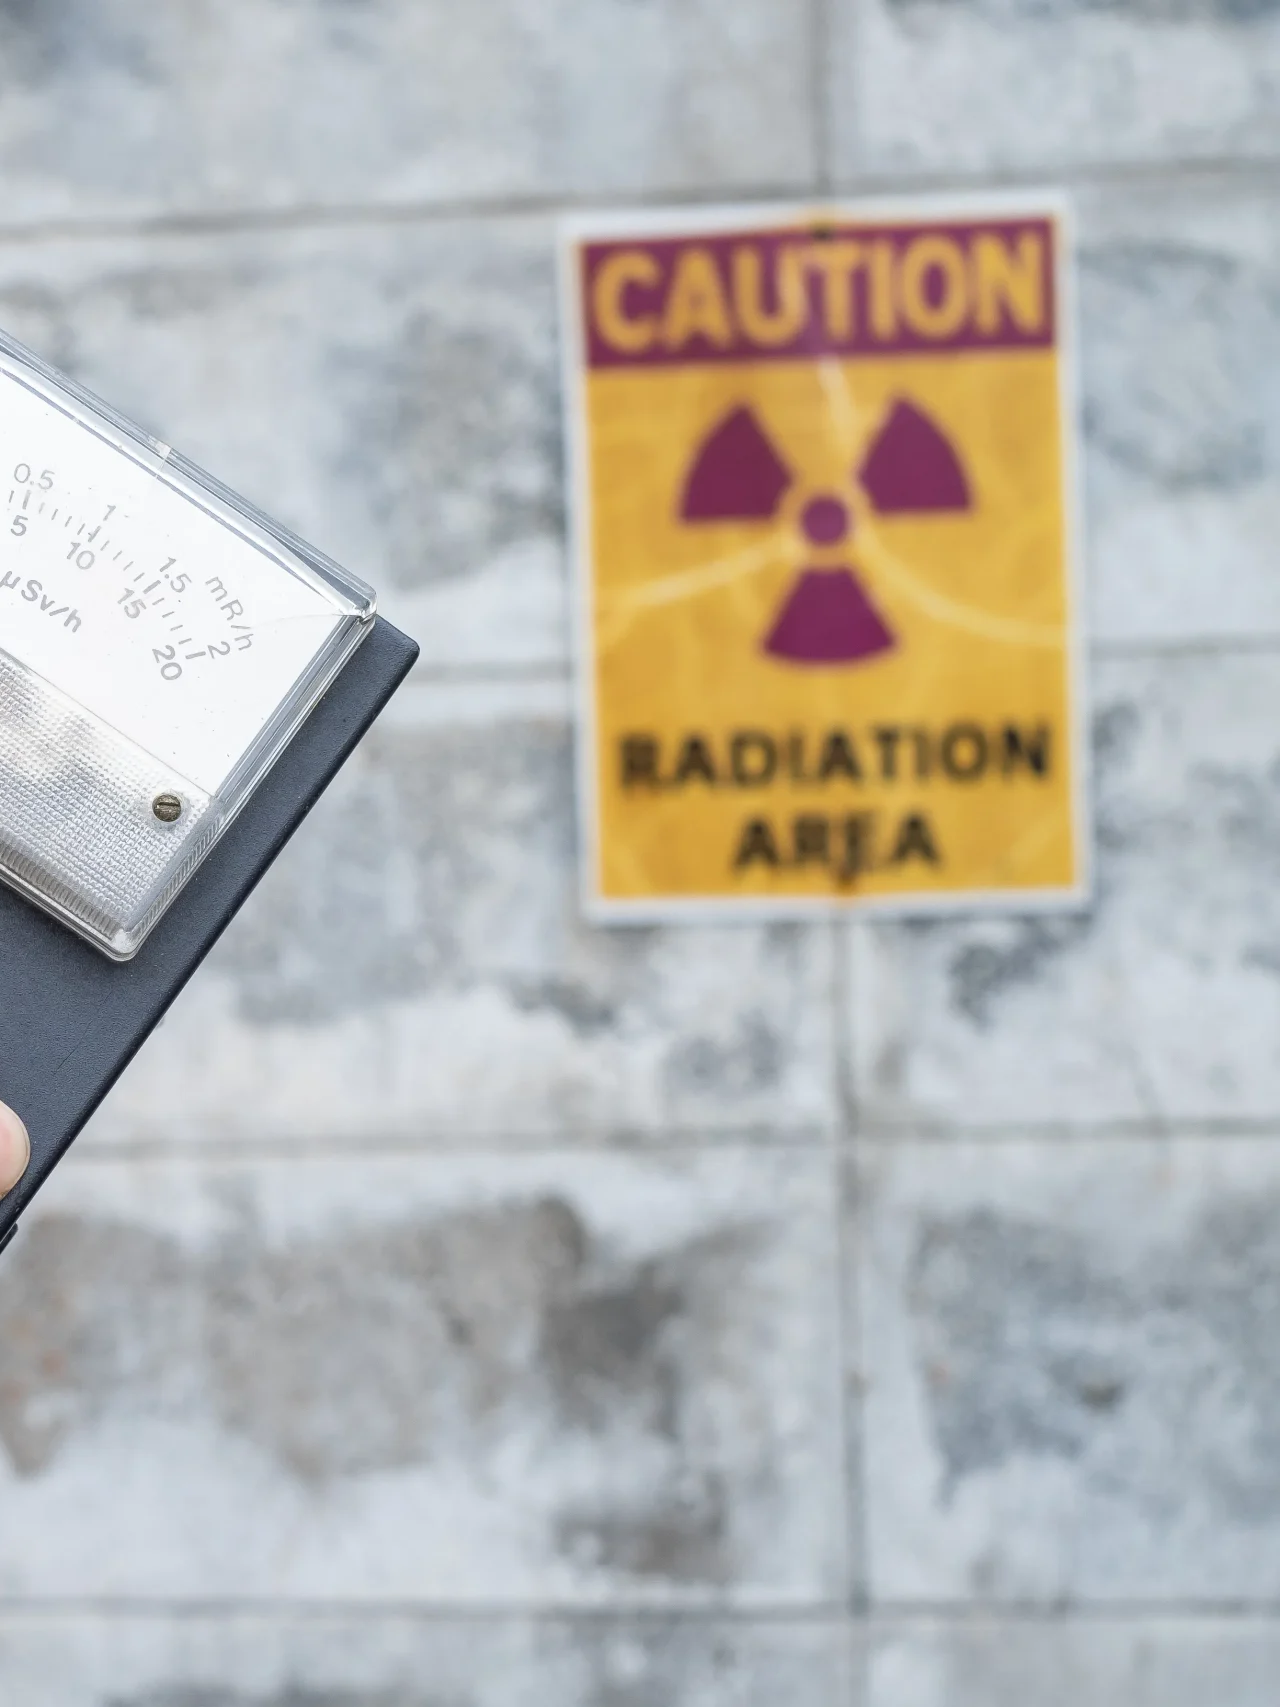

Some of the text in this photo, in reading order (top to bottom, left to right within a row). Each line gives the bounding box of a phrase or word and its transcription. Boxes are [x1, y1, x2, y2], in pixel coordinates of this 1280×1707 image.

[592, 232, 1044, 354] CAUTION
[10, 515, 28, 537] 5
[66, 542, 96, 570] 10
[117, 587, 147, 620] 15
[152, 645, 183, 681] 20
[13, 463, 55, 490] 0.5
[103, 504, 117, 522] 1
[158, 556, 192, 593] 1.5
[207, 640, 231, 659] 2
[205, 576, 253, 651] mR/h
[618, 722, 1053, 789] RADIATION
[732, 812, 942, 874] AREA
